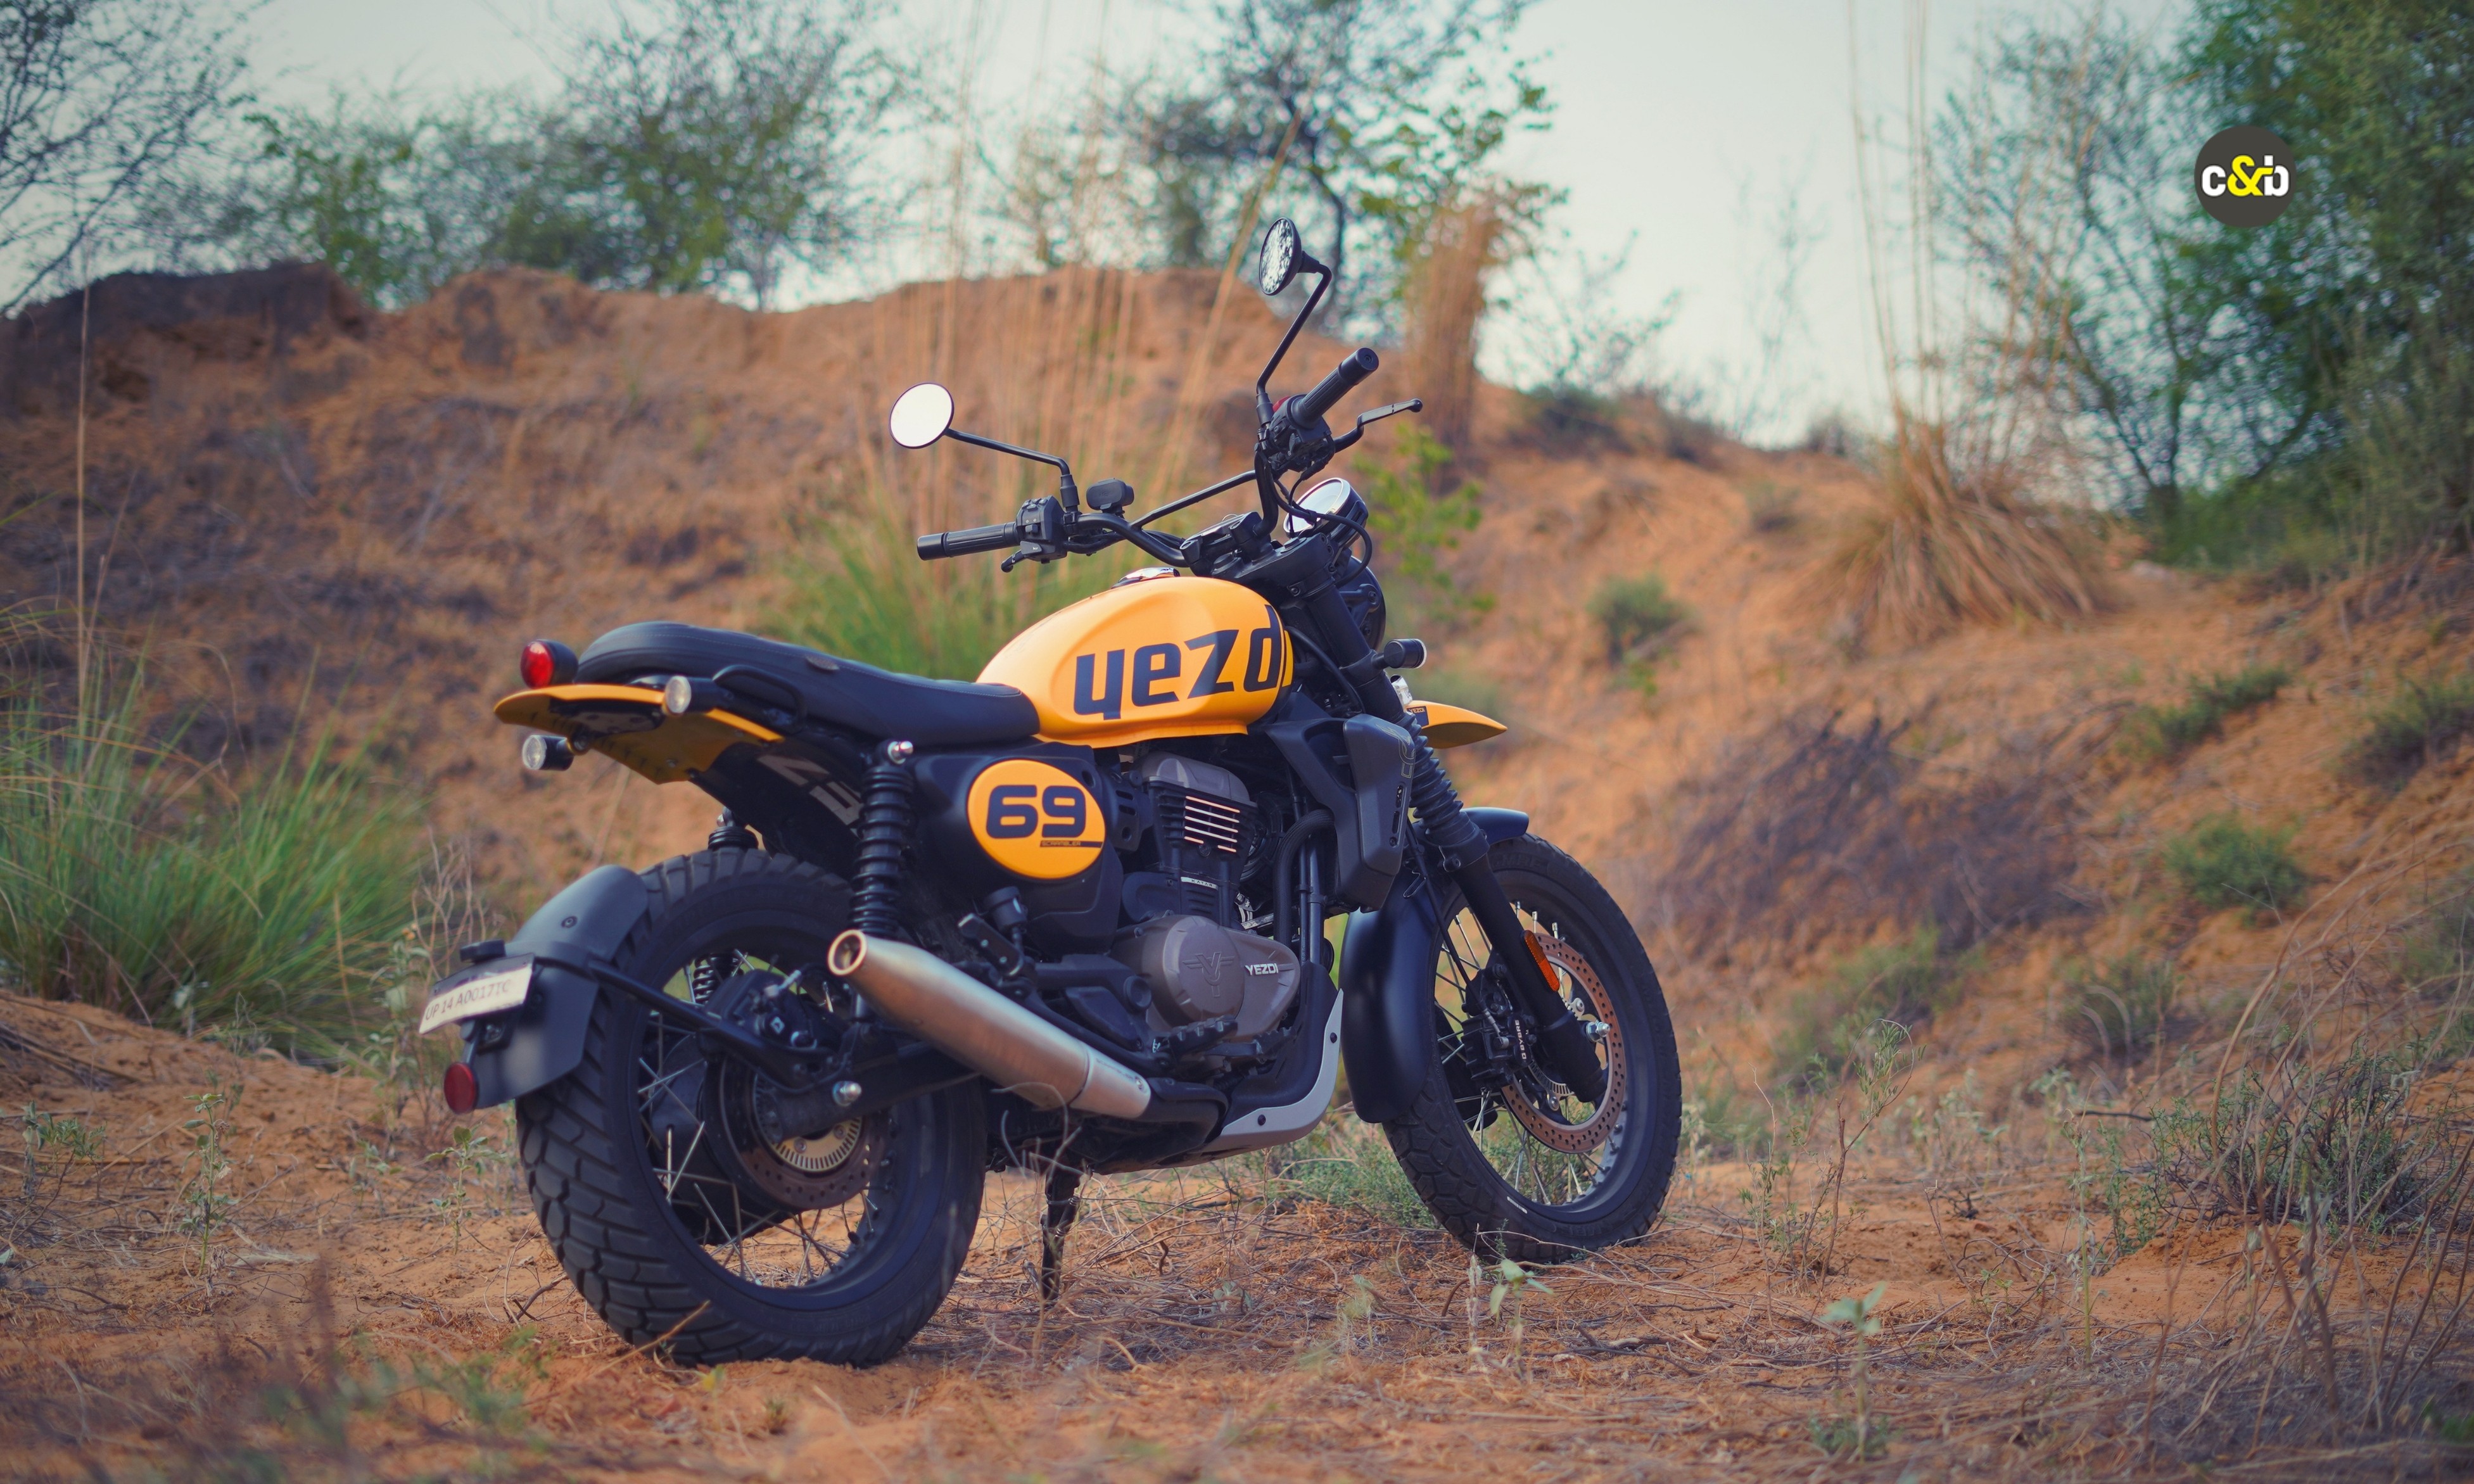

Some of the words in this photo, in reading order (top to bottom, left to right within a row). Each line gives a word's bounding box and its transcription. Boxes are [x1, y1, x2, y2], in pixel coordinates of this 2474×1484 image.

[986, 785, 1086, 839] 69
[1245, 963, 1279, 975] YEZDI
[425, 1003, 440, 1021] UP
[441, 997, 454, 1013] 14
